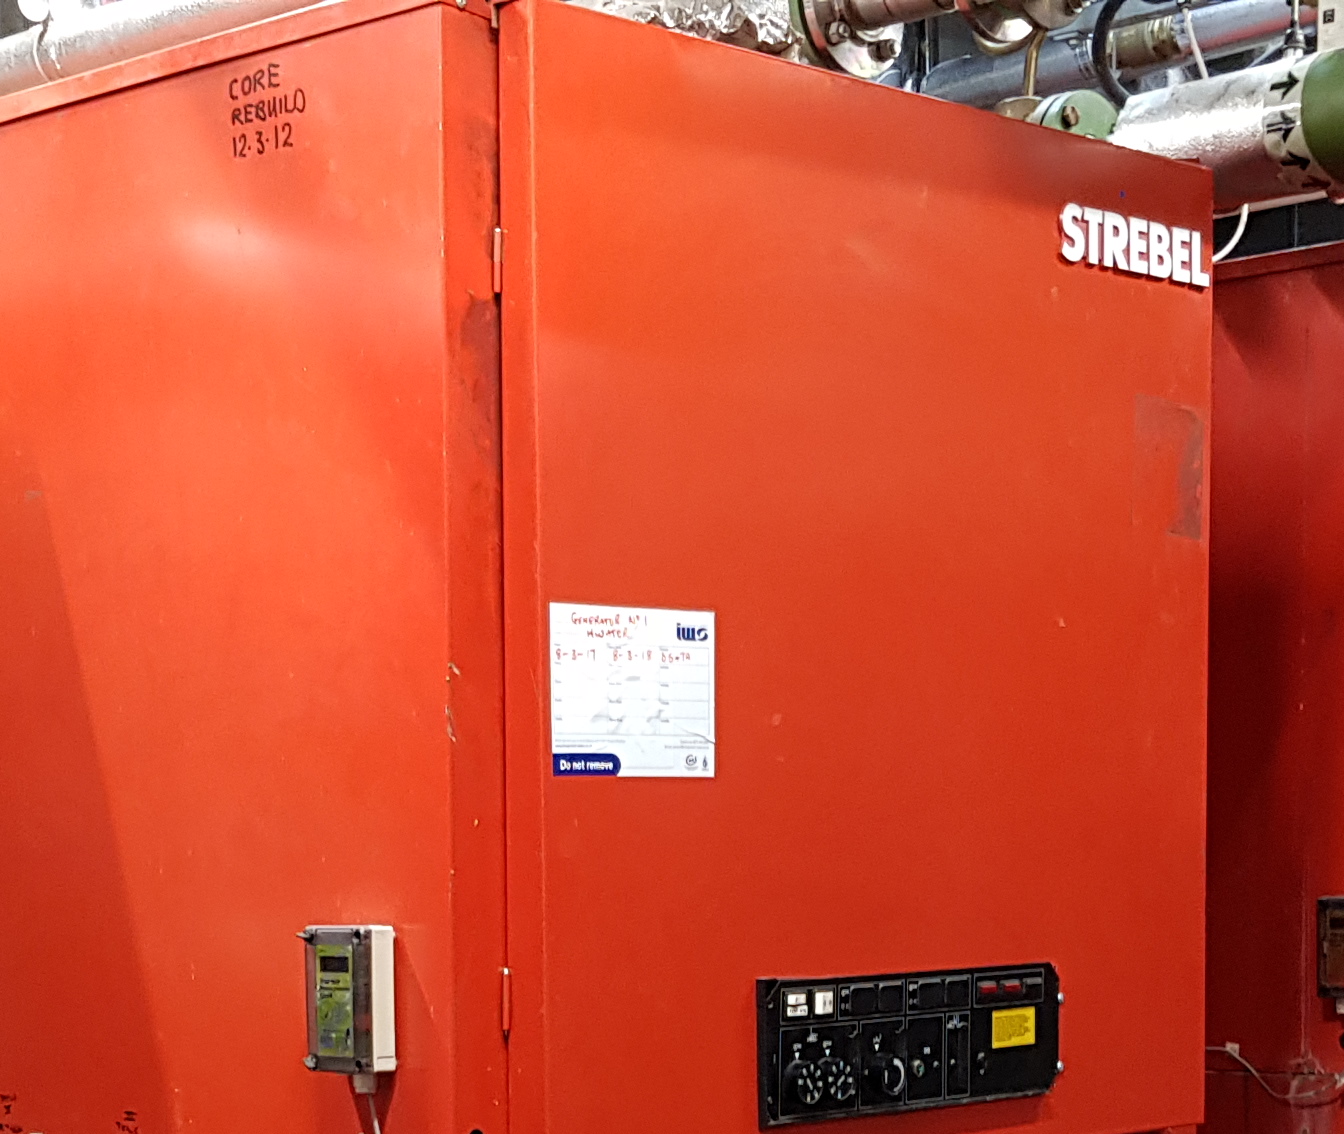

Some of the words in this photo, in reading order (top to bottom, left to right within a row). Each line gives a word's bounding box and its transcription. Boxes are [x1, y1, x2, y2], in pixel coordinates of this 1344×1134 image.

[229, 63, 280, 100] CORE
[231, 88, 306, 126] REBUILD
[1060, 202, 1210, 287] STREBEL
[560, 759, 571, 770] Do
[572, 759, 585, 770] not
[586, 760, 613, 771] remove
